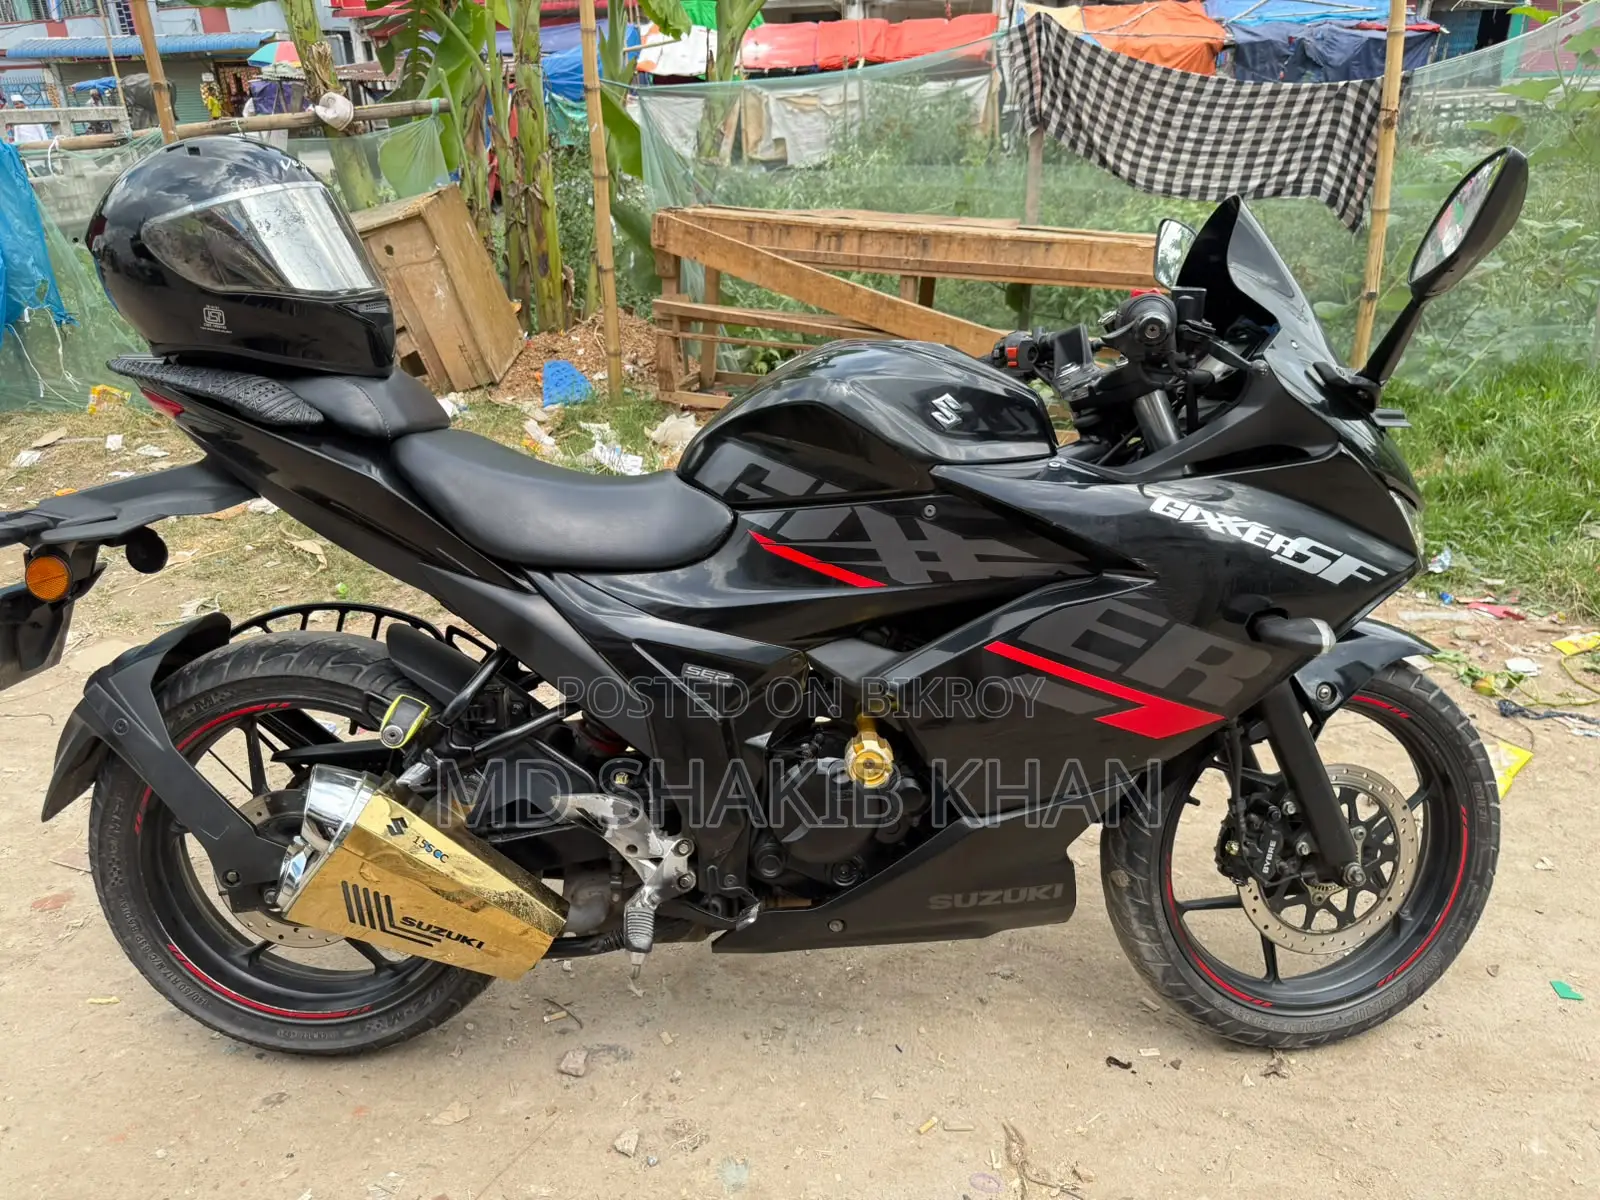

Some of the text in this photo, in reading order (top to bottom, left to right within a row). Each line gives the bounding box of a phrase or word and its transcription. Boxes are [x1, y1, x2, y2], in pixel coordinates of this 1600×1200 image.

[685, 666, 730, 680] SEP
[1262, 840, 1277, 874] BYBRE
[928, 883, 1064, 910] SUZUKI
[400, 916, 485, 950] SUZUKI
